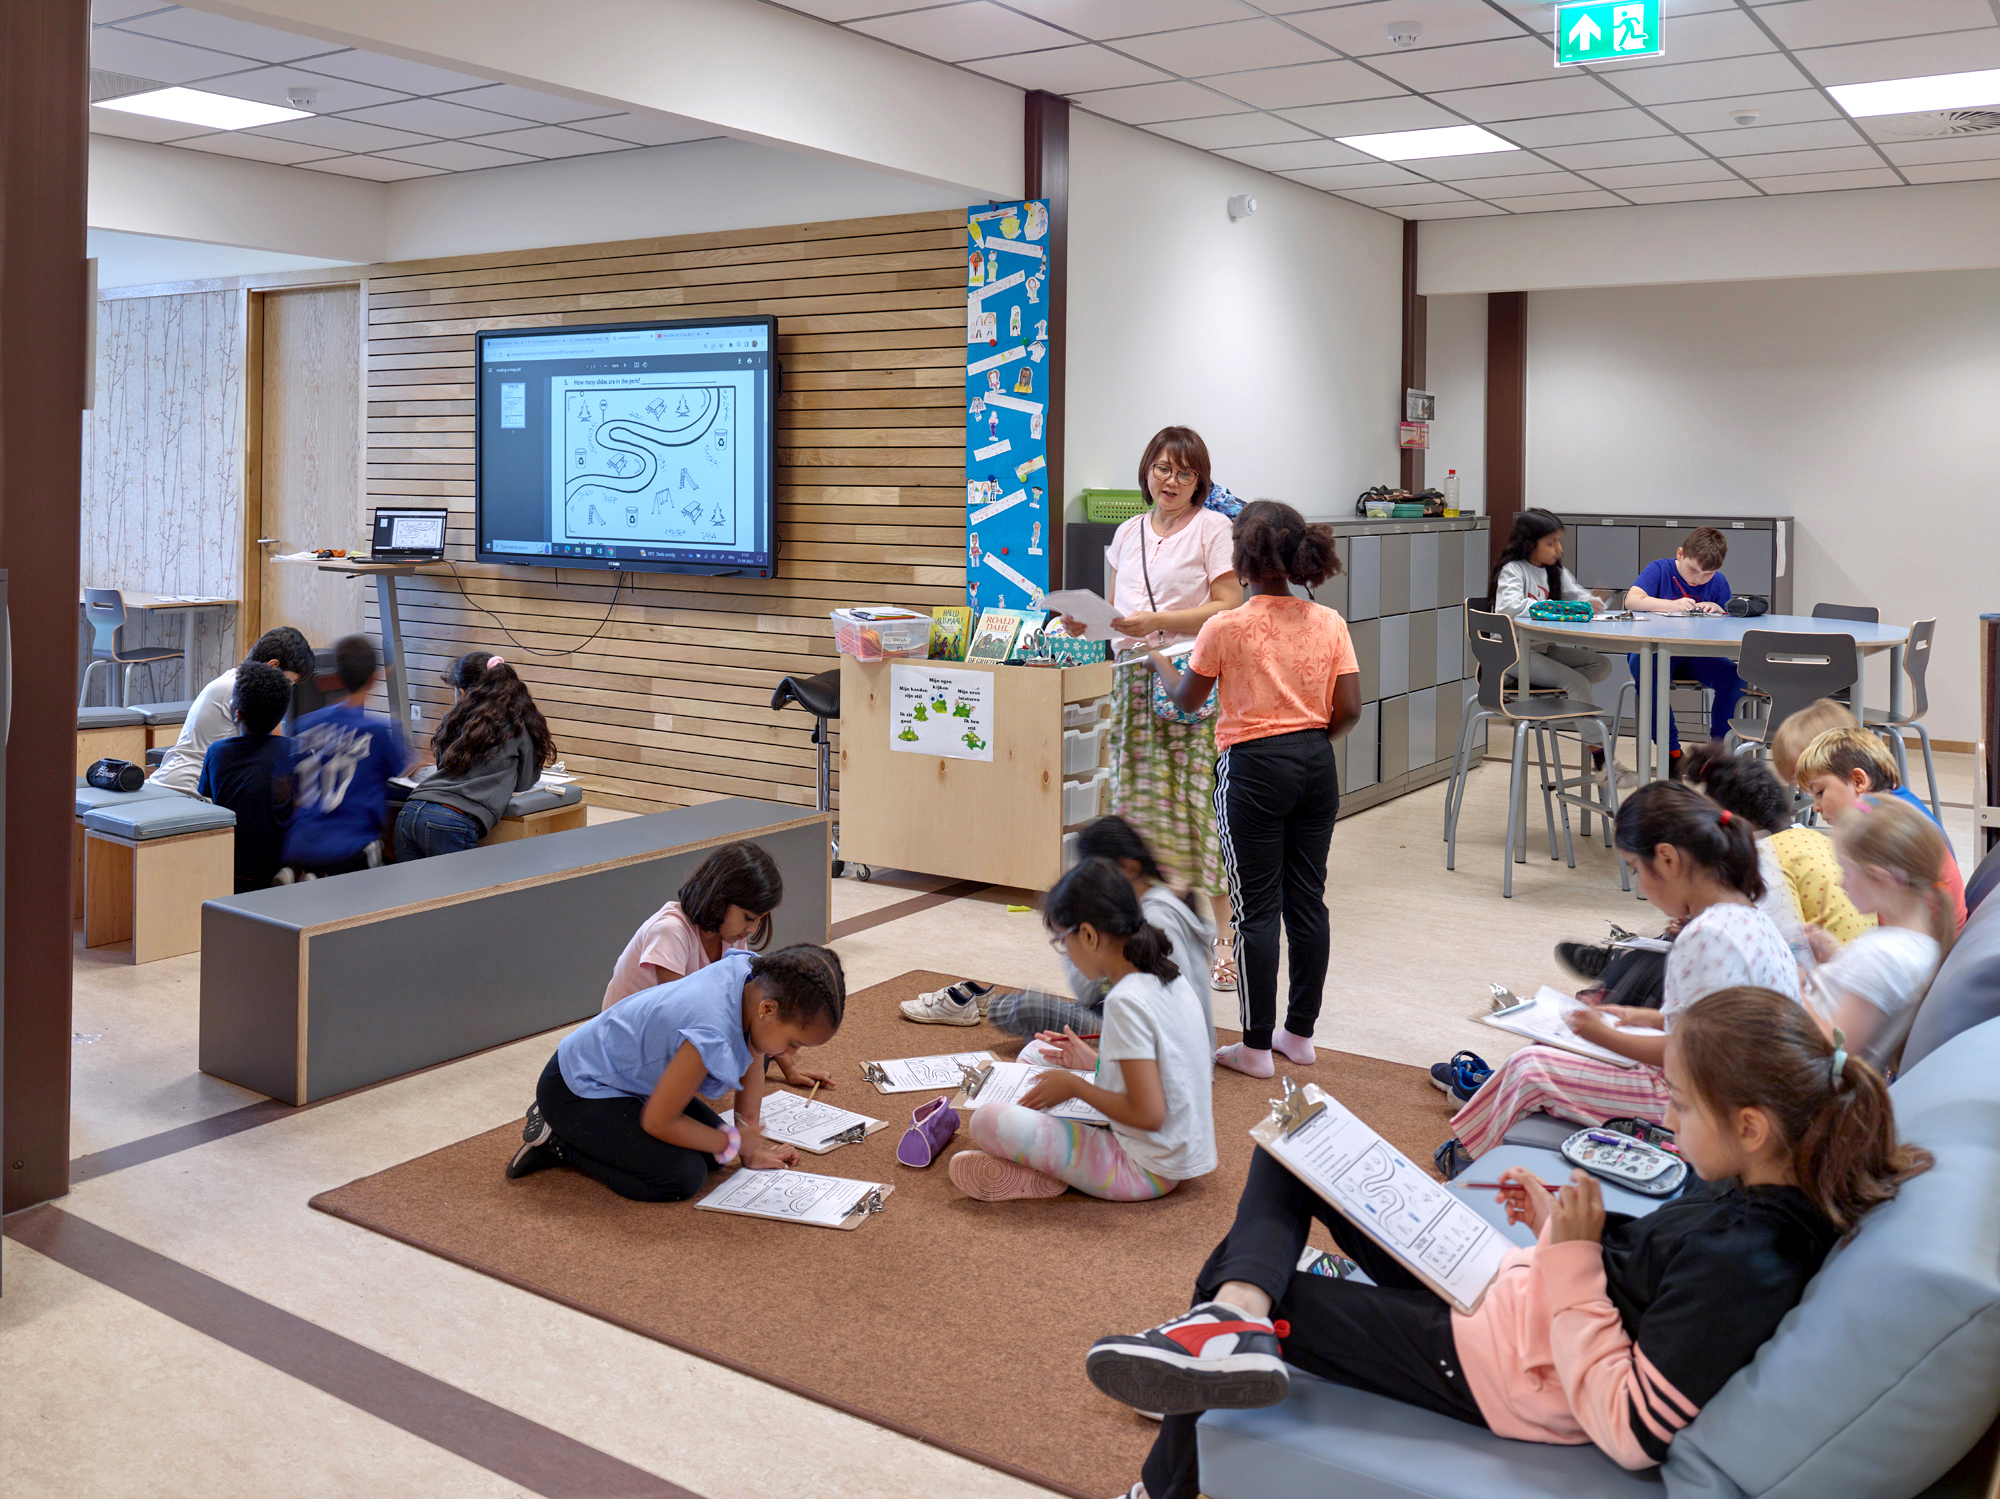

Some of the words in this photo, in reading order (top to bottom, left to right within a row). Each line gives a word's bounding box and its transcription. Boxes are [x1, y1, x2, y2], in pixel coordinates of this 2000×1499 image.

[629, 377, 641, 385] park?
[943, 609, 960, 618] HALLO
[986, 616, 1015, 625] ROALD
[986, 624, 1009, 632] DAHL
